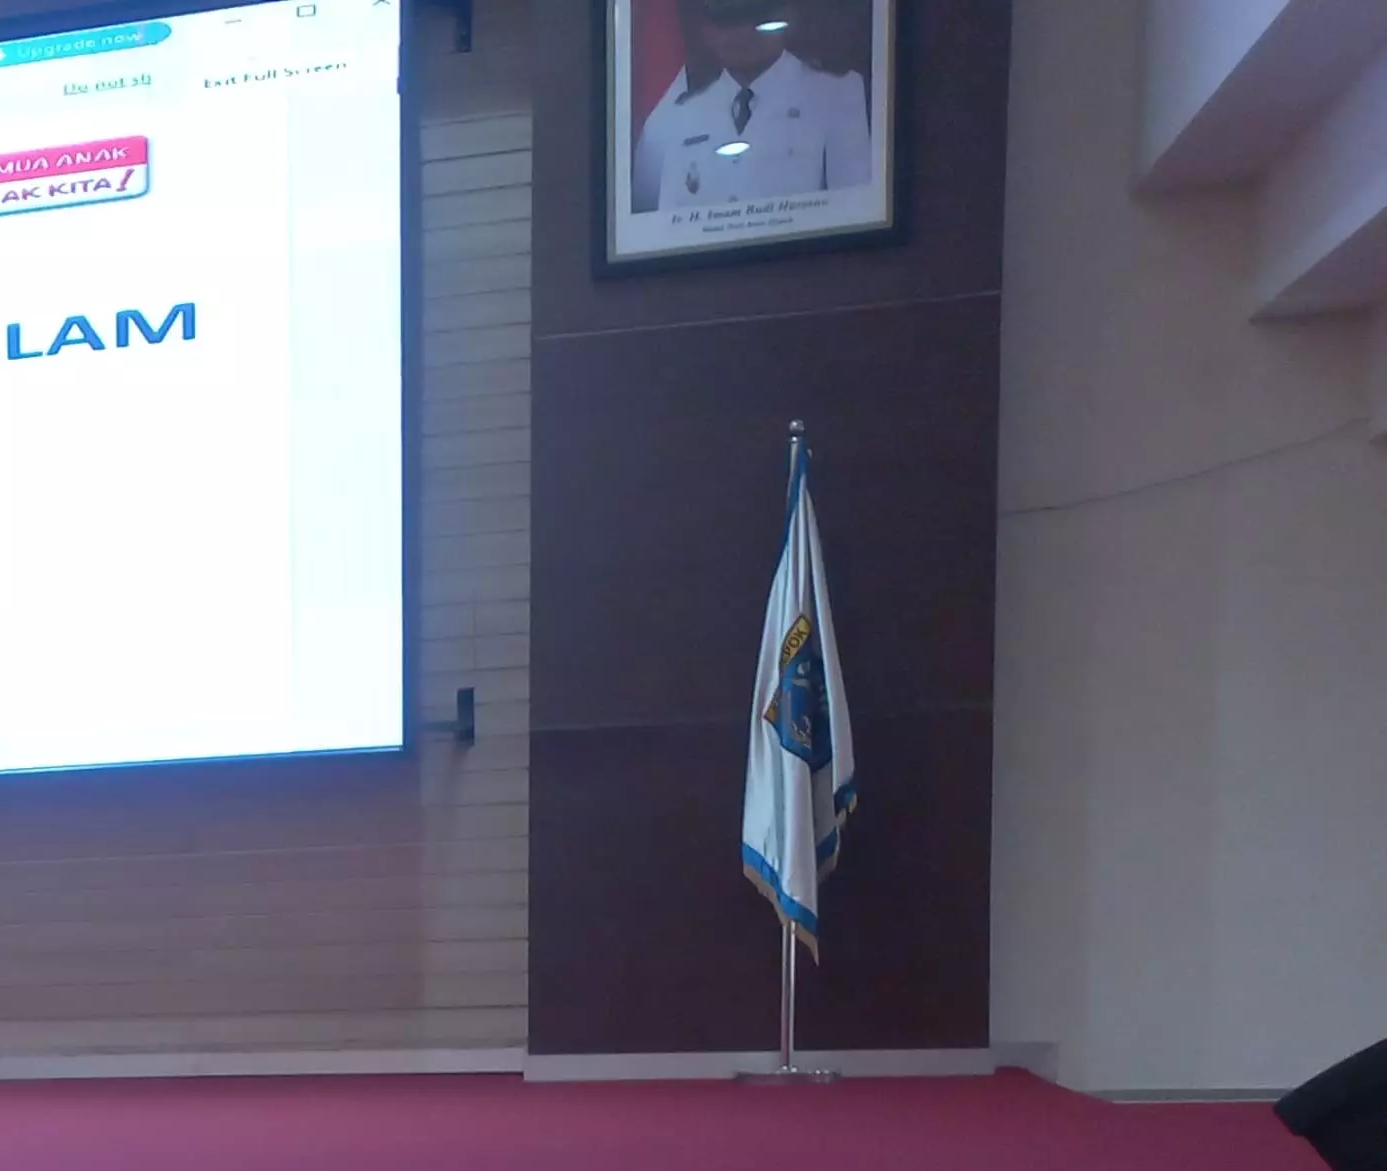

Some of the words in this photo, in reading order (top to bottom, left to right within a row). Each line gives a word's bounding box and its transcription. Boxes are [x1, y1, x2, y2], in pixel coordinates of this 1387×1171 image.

[17, 36, 97, 59] Upgrade
[100, 30, 143, 46] now
[55, 146, 130, 168] ANAK
